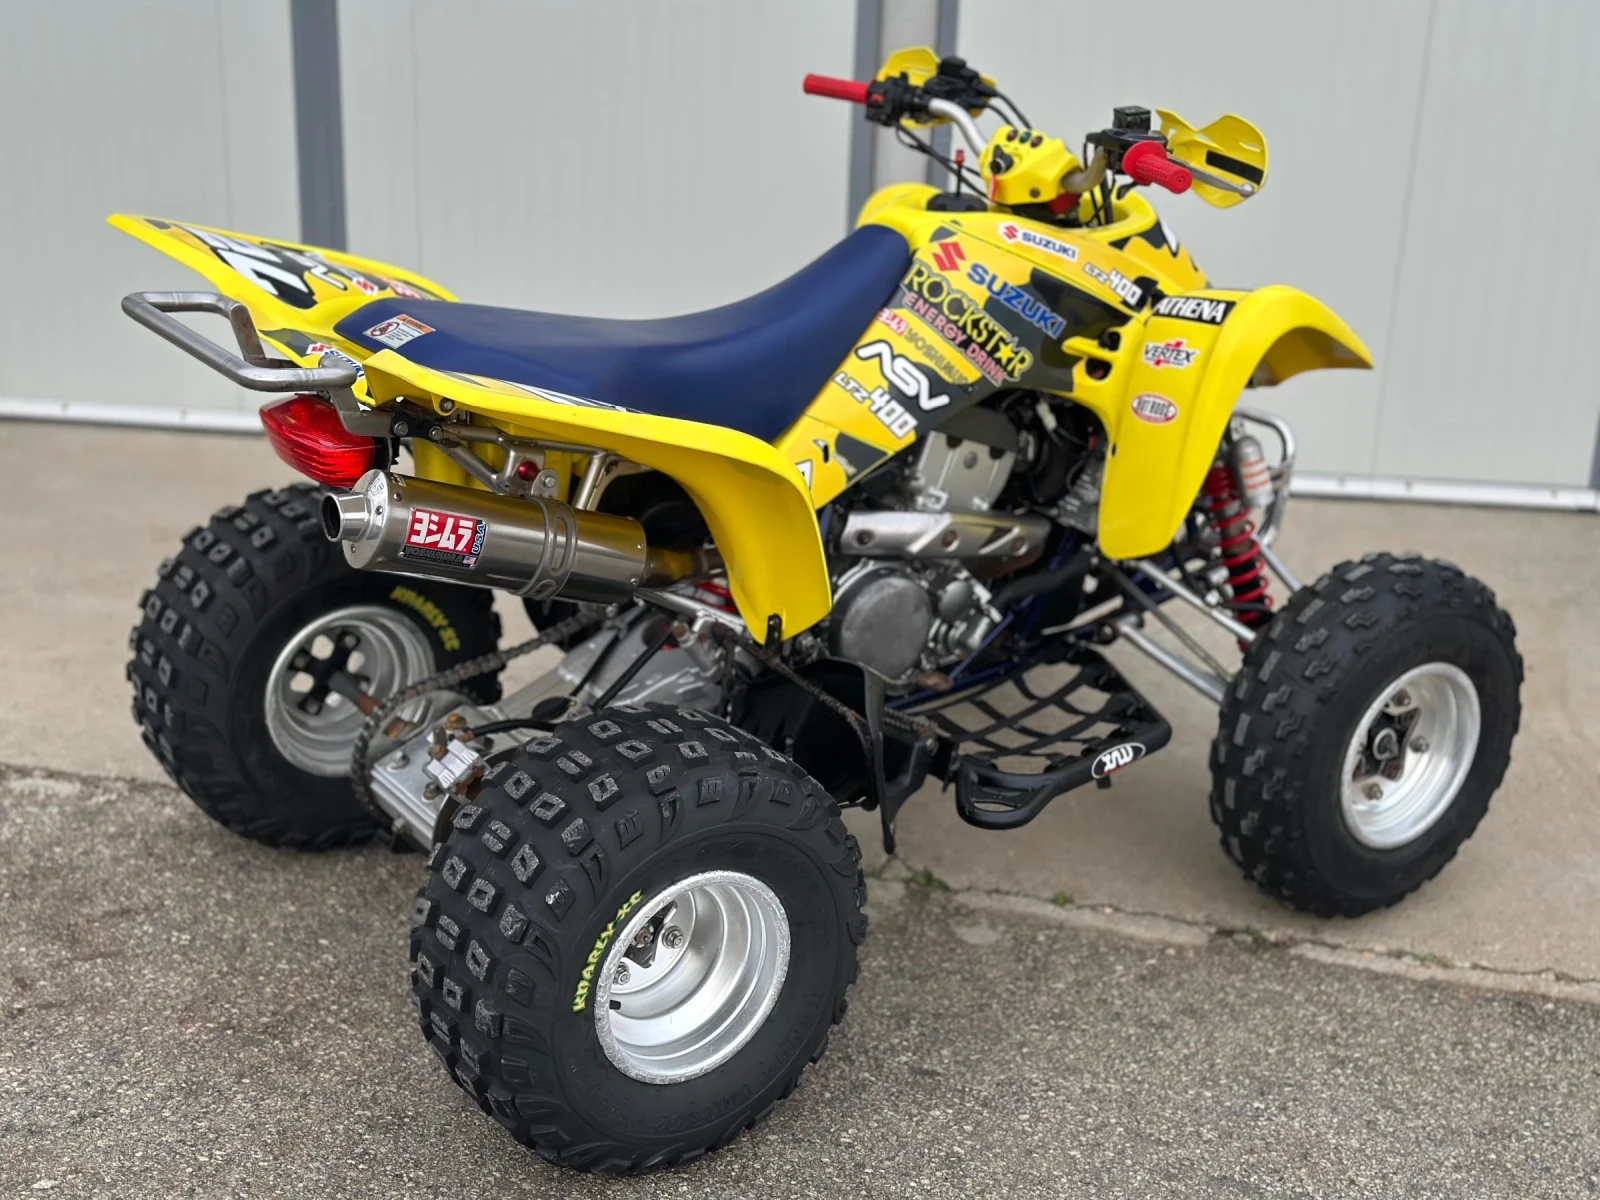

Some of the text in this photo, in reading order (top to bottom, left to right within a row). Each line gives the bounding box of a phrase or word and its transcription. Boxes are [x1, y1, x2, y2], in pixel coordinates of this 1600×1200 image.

[1022, 232, 1077, 259] SUZUKI
[966, 262, 1067, 340] SUZUKI
[1154, 296, 1228, 323] ATHENA
[904, 291, 1007, 383] ENERGY DRINK
[1144, 343, 1197, 363] VERTEX
[856, 340, 951, 411] ASV
[410, 511, 474, 552] ヨシムラ
[471, 523, 486, 555] USA
[571, 921, 616, 1013] KNARLY
